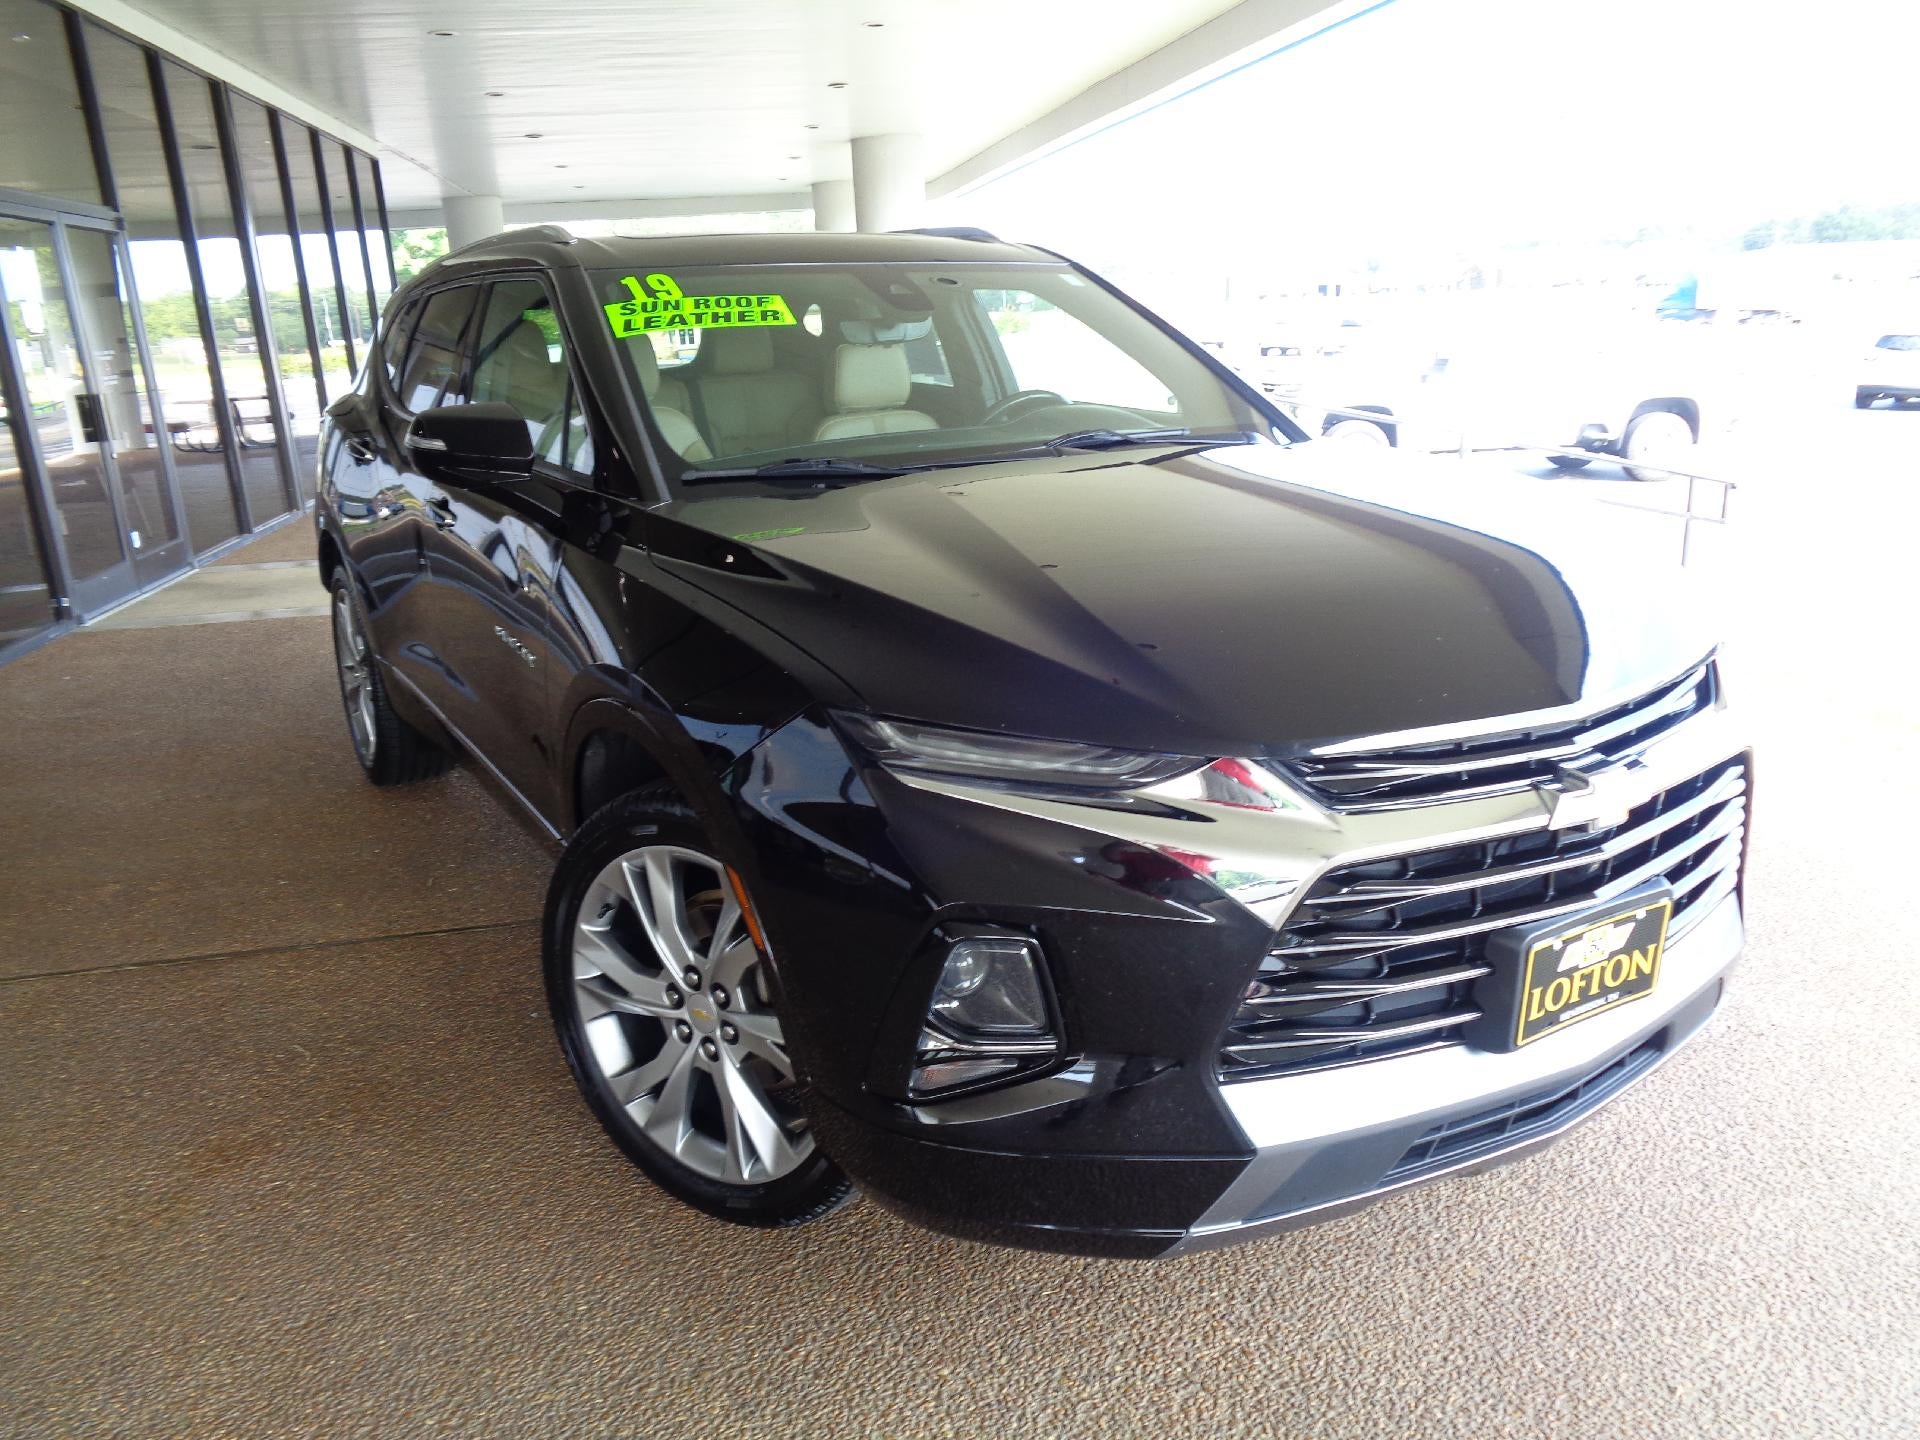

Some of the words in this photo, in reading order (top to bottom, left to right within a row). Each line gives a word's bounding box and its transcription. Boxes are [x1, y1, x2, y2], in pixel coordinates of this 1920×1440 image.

[620, 274, 684, 301] 19
[619, 299, 681, 316] SUN
[693, 296, 772, 310] ROOF
[622, 309, 782, 333] LEATHER
[1528, 943, 1657, 1022] LOFTON
